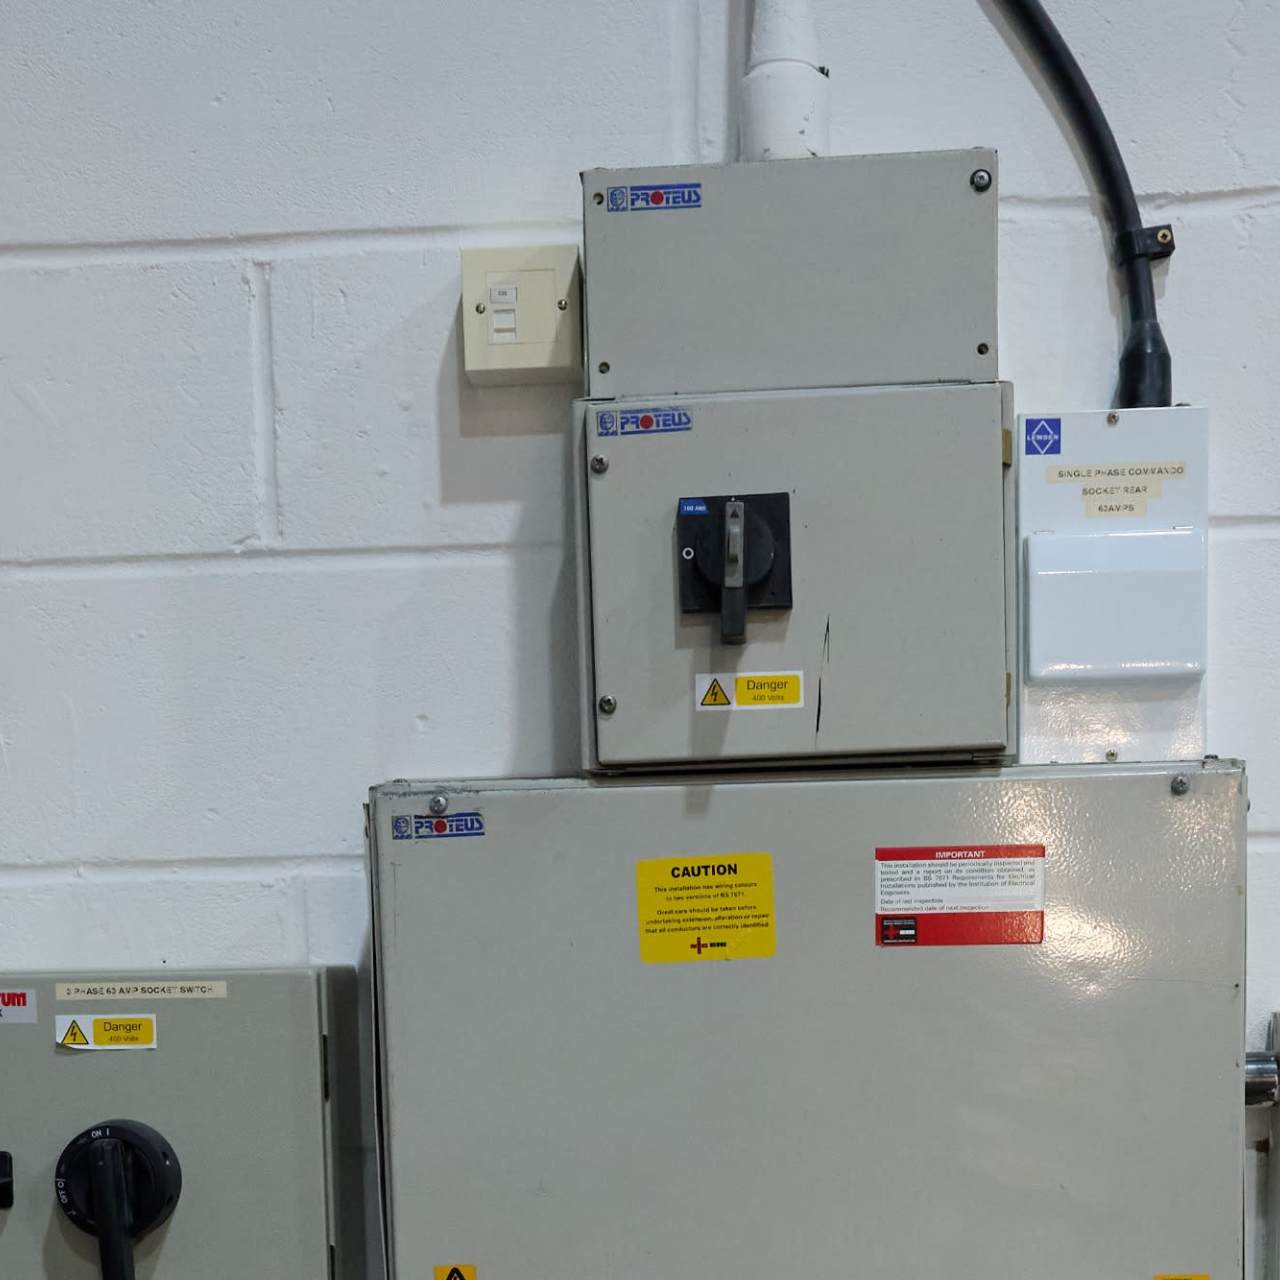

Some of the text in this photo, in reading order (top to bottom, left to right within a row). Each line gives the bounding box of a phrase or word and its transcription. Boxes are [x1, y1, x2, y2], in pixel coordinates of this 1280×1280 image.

[630, 190, 702, 206] PROTEUS
[620, 412, 692, 430] PROTEUS
[1058, 466, 1184, 478] SINGLE PHASE COMMANDO
[1082, 485, 1149, 496] SOCKET REAR
[746, 680, 788, 691] Danger
[414, 817, 484, 834] PROTEUS
[935, 851, 985, 859] IMPORTANT
[671, 863, 738, 879] CAUTION
[74, 987, 104, 995] PHASE
[118, 986, 139, 995] AMP
[140, 986, 178, 994] SOCKET
[180, 985, 214, 993] SWITCH
[103, 1022, 143, 1033] Danger
[92, 1129, 102, 1138] ON
